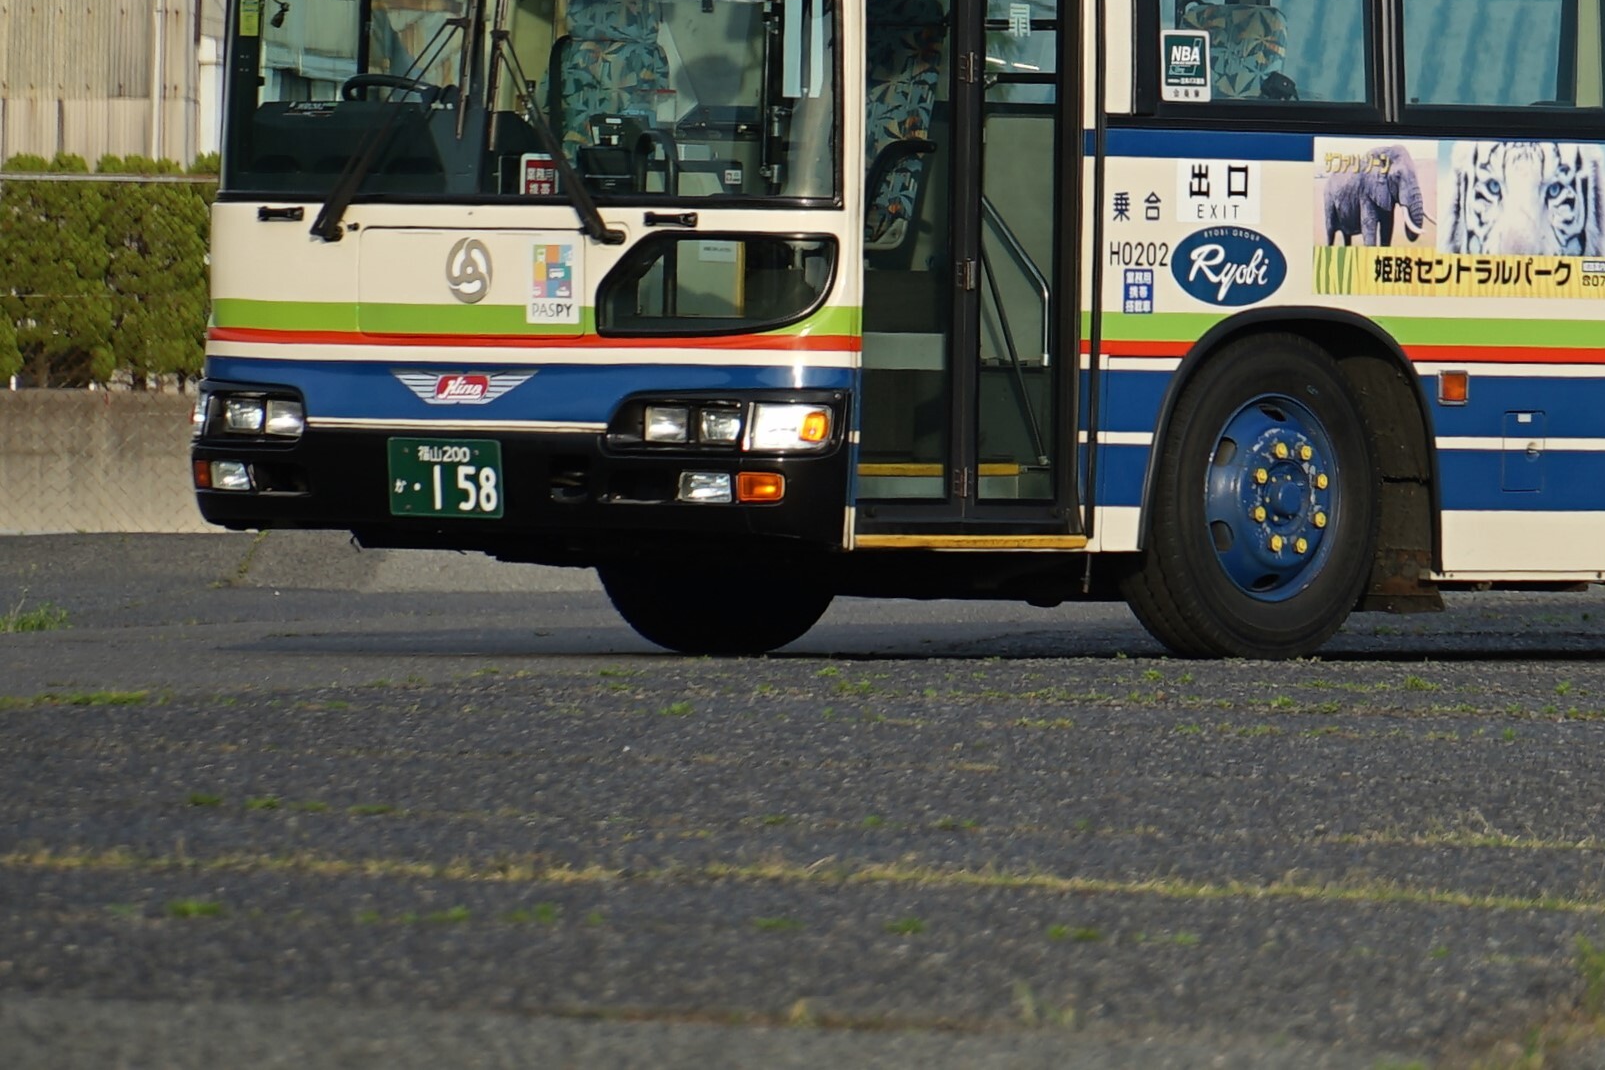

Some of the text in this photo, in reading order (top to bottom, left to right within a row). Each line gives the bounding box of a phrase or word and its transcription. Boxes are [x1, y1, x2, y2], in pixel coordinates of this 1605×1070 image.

[1171, 45, 1201, 62] NBA
[1189, 163, 1250, 199] 出口
[1113, 191, 1161, 221] 乗合
[1197, 204, 1240, 219] EXIT
[1109, 241, 1169, 267] H0202
[1188, 243, 1269, 302] Ryobi
[1374, 256, 1573, 287] 姫路セントラルパーク
[532, 303, 573, 317] PASPY
[438, 378, 483, 400] Hino
